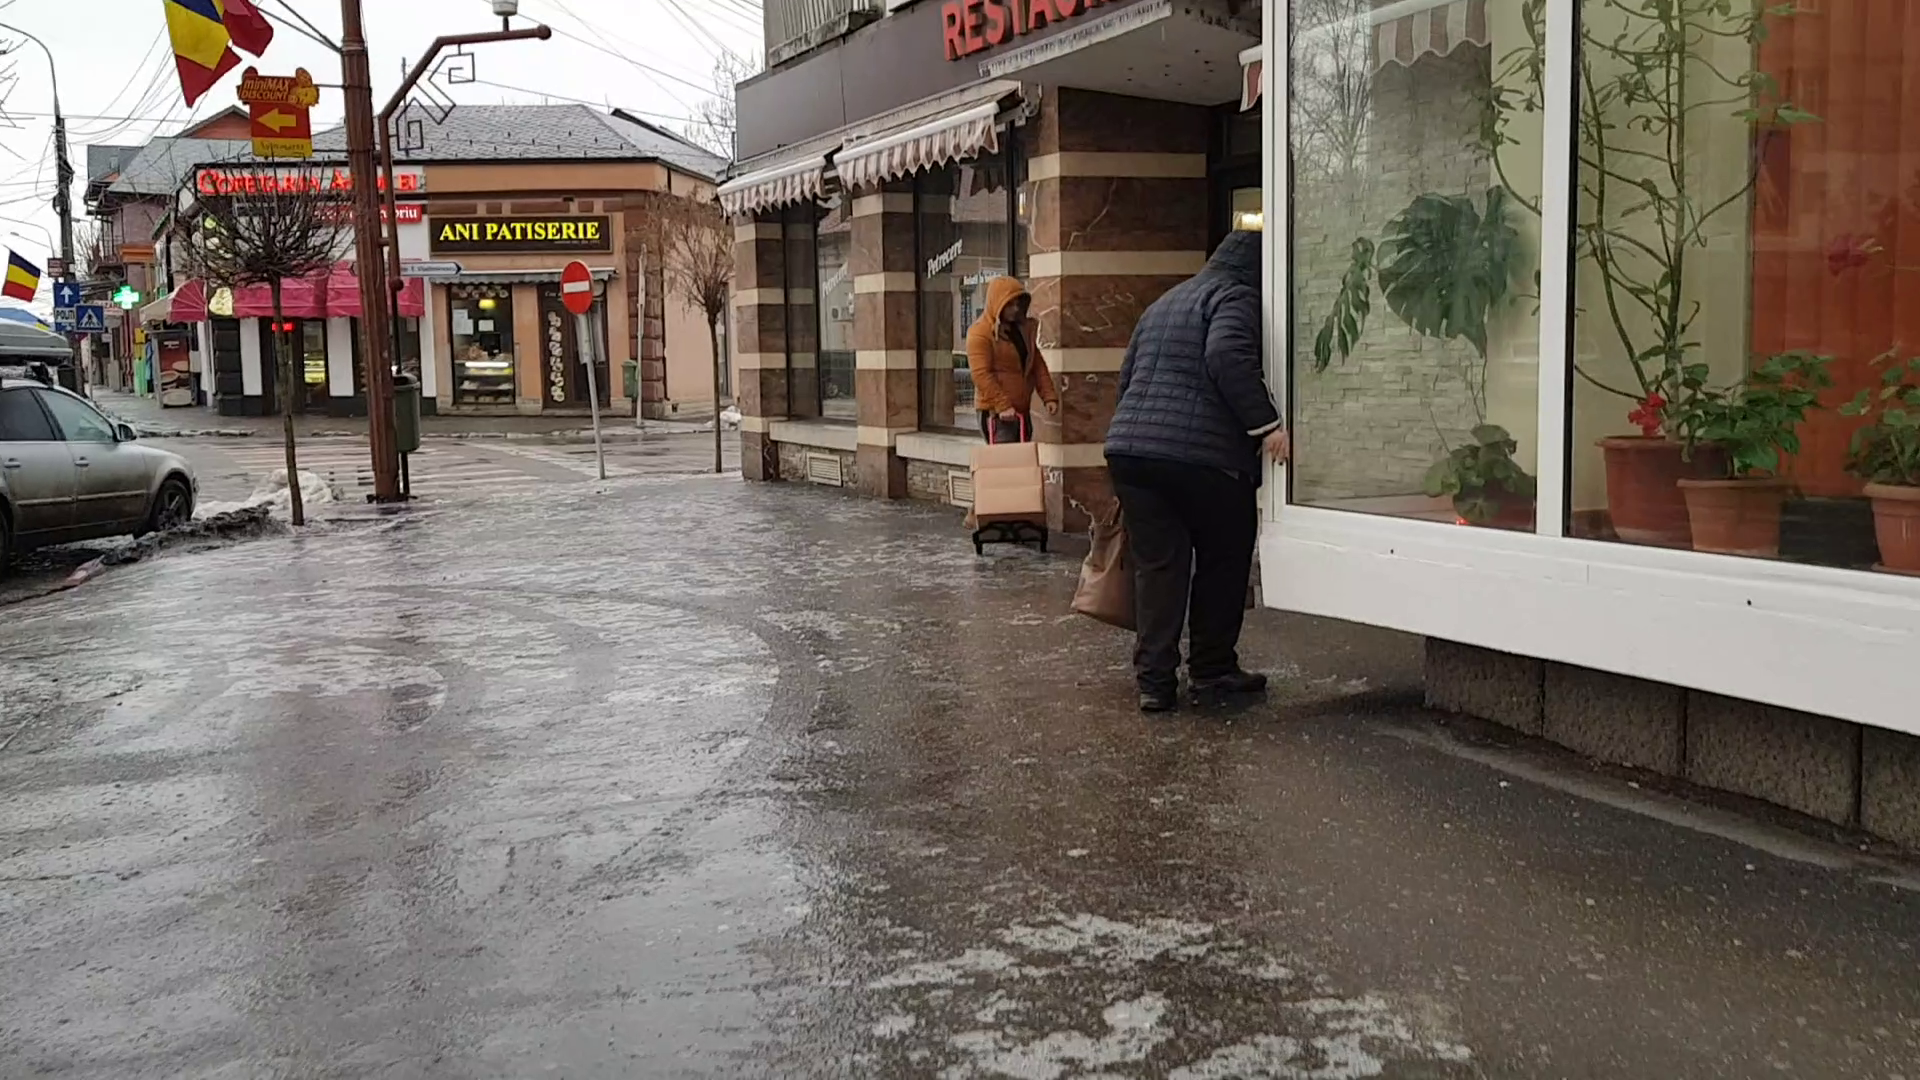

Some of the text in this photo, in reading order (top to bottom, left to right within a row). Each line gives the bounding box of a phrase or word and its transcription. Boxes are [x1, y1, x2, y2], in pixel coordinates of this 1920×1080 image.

[241, 90, 287, 100] DISCOUNT
[440, 221, 600, 241] ANI PATISERIE
[927, 238, 963, 279] Petrecere
